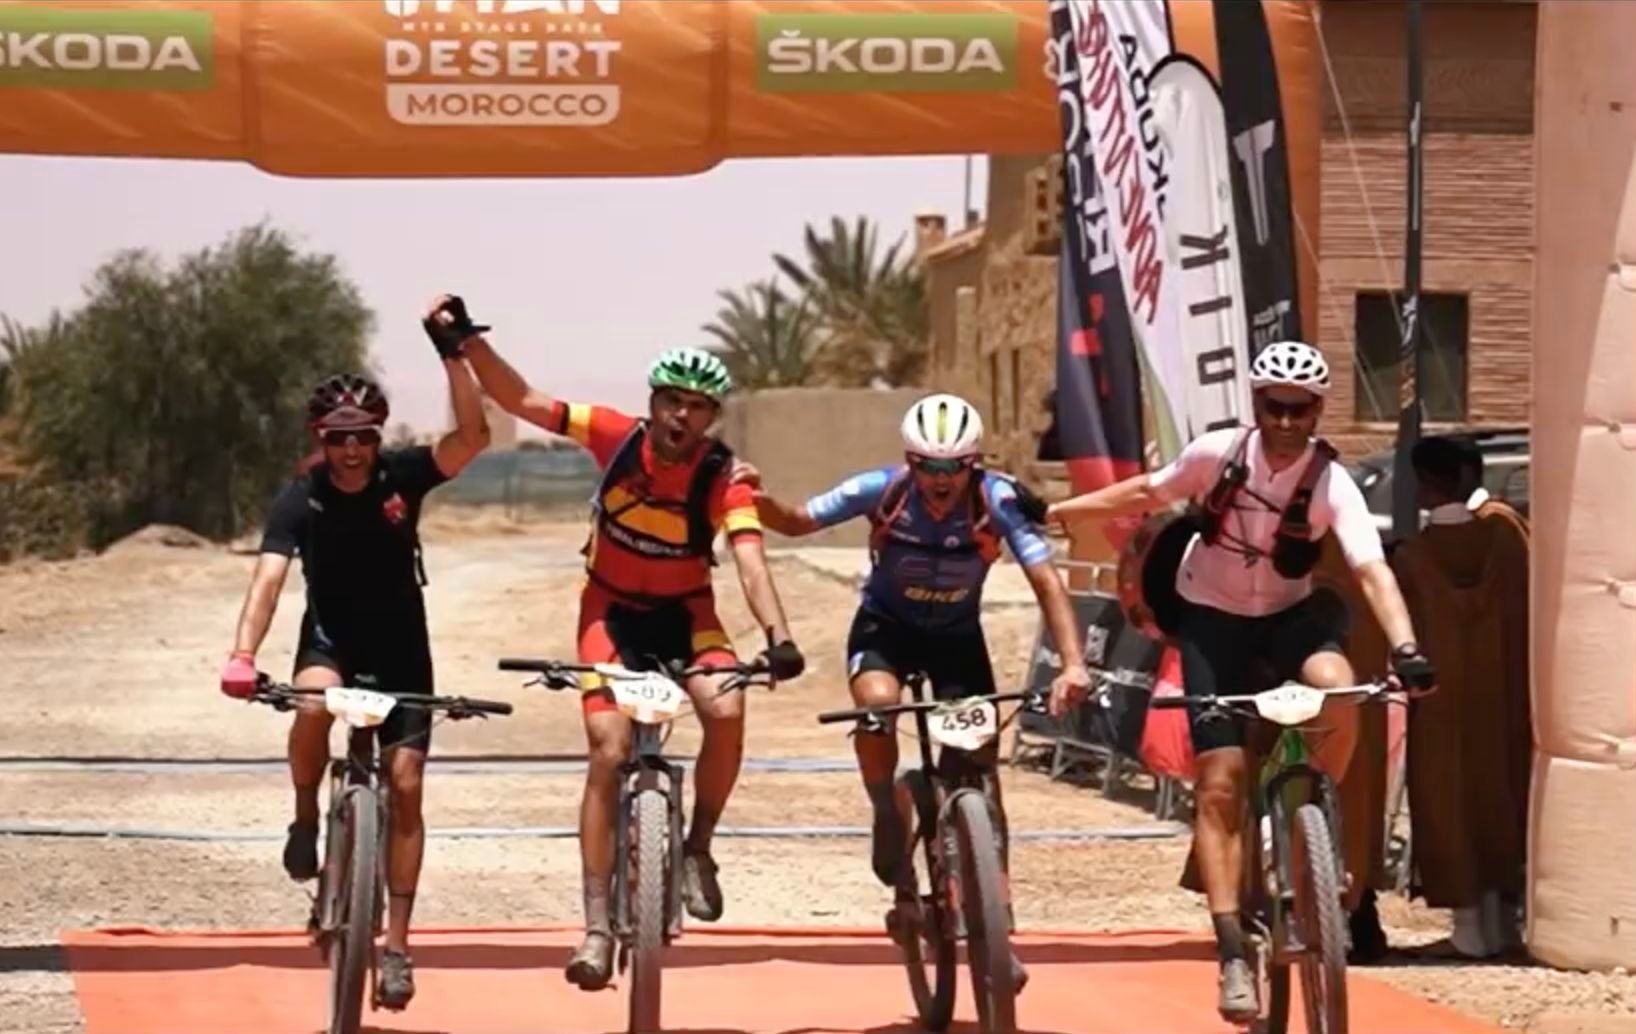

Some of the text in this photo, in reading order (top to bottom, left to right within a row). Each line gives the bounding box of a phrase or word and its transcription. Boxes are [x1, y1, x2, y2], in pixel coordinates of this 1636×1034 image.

[0, 32, 203, 72] KODA
[385, 40, 622, 77] DESERT
[767, 29, 1005, 73] ŠKODA
[406, 93, 607, 117] MOROCCO
[942, 708, 987, 731] 458
